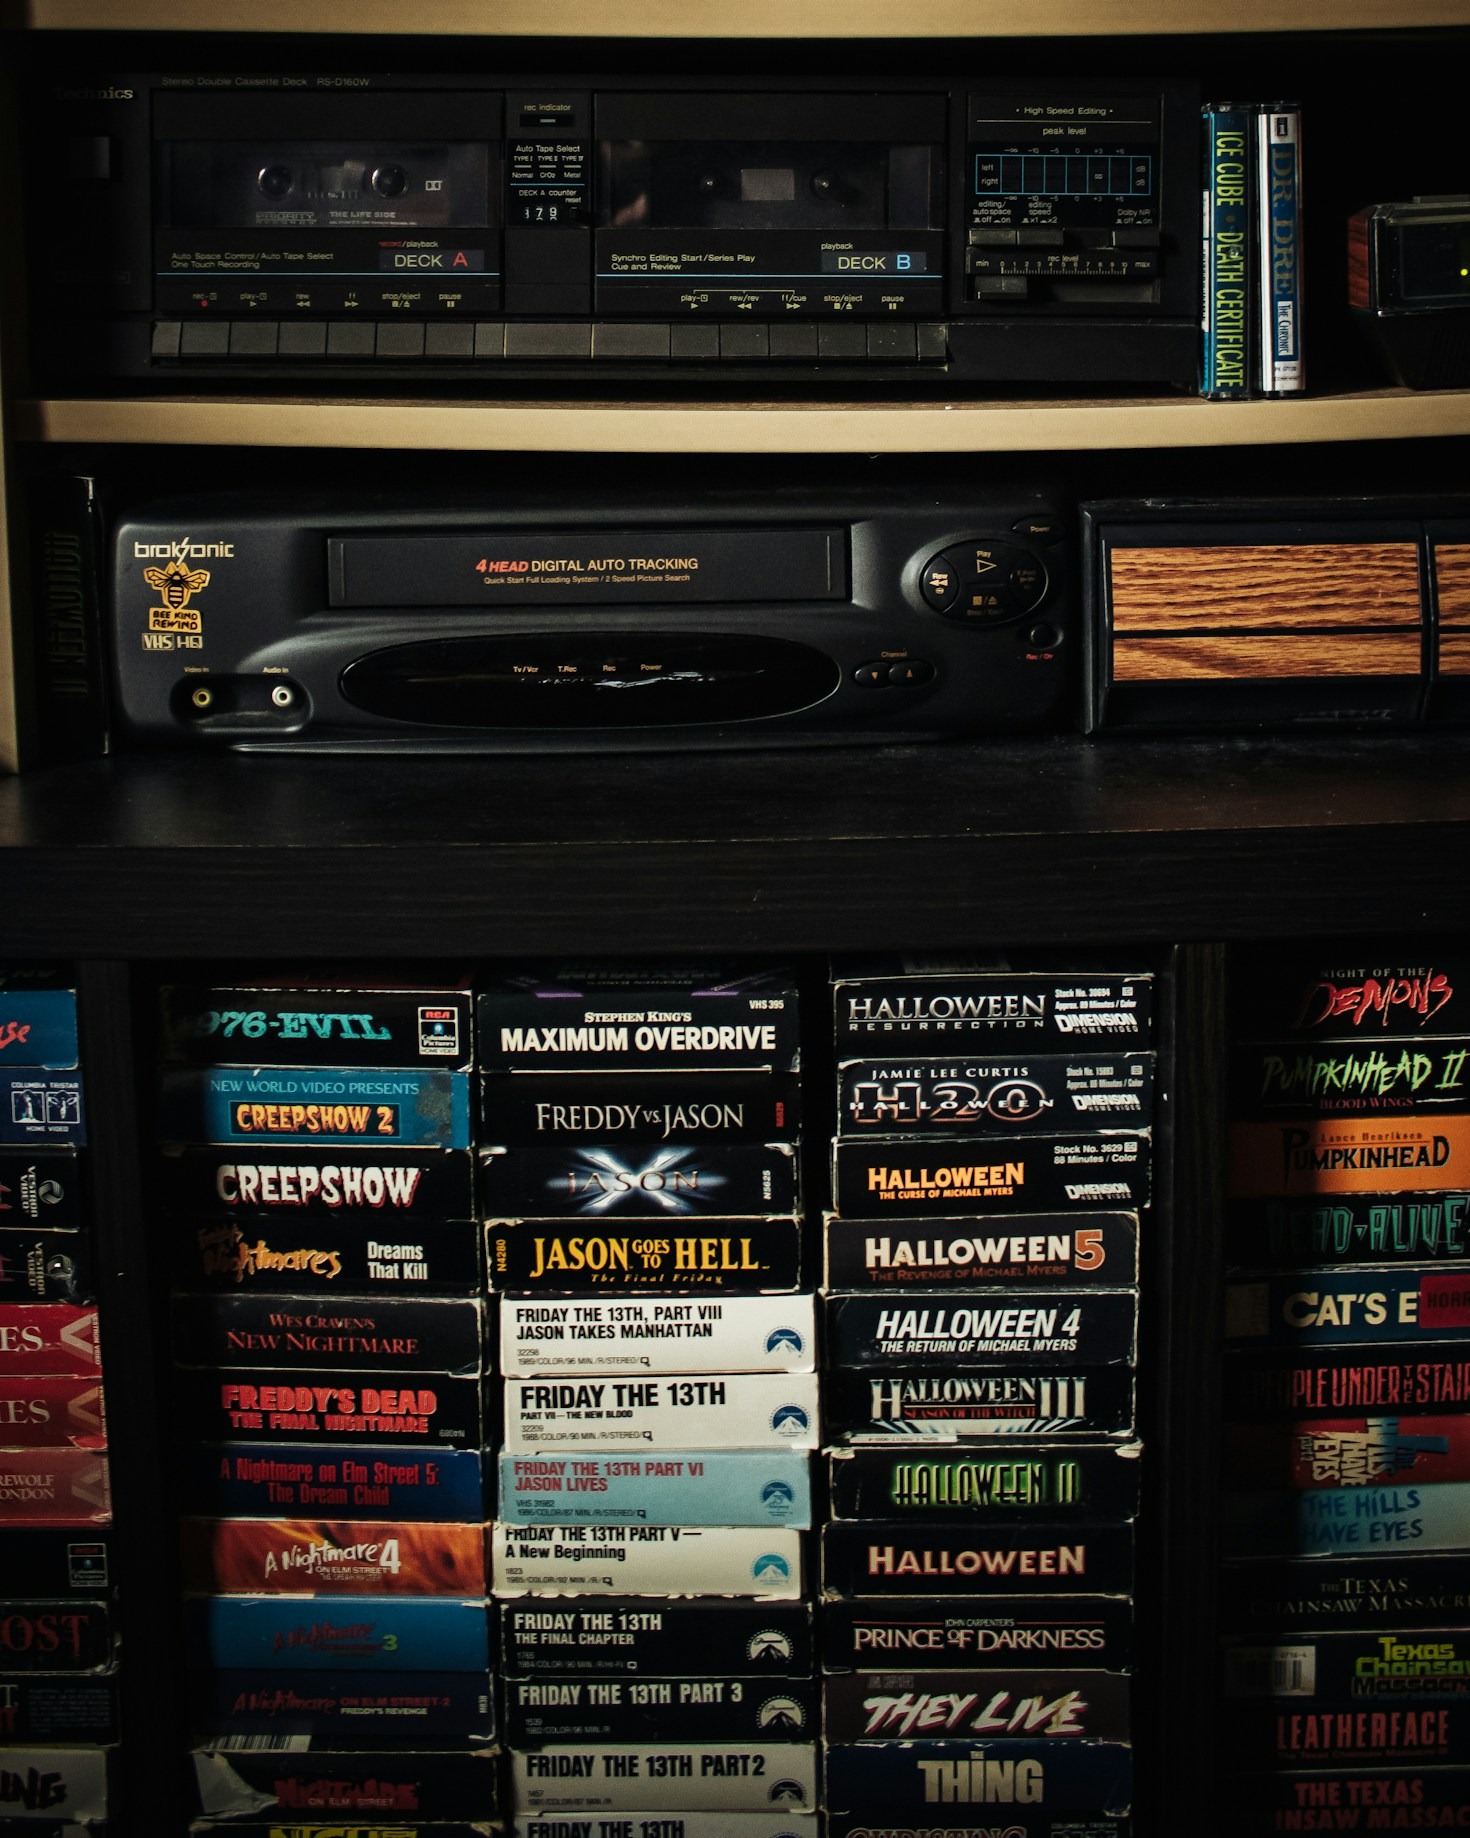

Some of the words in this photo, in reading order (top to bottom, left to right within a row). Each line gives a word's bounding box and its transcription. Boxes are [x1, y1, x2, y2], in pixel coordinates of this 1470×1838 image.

[162, 78, 194, 87] Stereo
[197, 78, 232, 87] Double
[234, 78, 279, 87] Cassette
[282, 78, 307, 87] Deck
[524, 104, 536, 112] rec
[538, 103, 572, 112] indicator
[1024, 106, 1043, 115] High
[1046, 106, 1074, 116] Speed
[1078, 106, 1106, 116] Editing
[1042, 127, 1064, 136] peak
[1068, 126, 1087, 136] level
[516, 145, 534, 153] Auto
[535, 145, 554, 154] Tape
[556, 145, 580, 153] Select
[1216, 130, 1244, 158] ICE
[1216, 162, 1244, 206] CUBE
[820, 242, 854, 251] playback
[1274, 216, 1296, 295] DRE
[170, 260, 186, 269] One
[188, 260, 212, 269] Touch
[214, 260, 260, 270] Recording
[394, 254, 442, 268] DECK
[452, 252, 469, 268] A
[610, 253, 648, 264] Synchro
[650, 253, 678, 264] Editing
[737, 253, 756, 264] Play
[610, 262, 628, 271] Cue
[630, 262, 648, 271] and
[650, 262, 682, 271] Review
[838, 256, 886, 271] DECK
[896, 254, 911, 270] B
[1216, 232, 1244, 282] DEATH
[1277, 304, 1292, 319] THE
[1215, 288, 1244, 388] CERTIFICATE
[1277, 320, 1292, 354] CHRONIC
[475, 559, 488, 574] 4
[488, 560, 529, 573] HEAD
[531, 560, 585, 572] DIGITAL
[587, 559, 626, 572] AUTO
[628, 558, 699, 571] TRACKING
[484, 576, 504, 584] Quick
[506, 576, 524, 584] Start
[525, 576, 538, 584] Full
[540, 576, 570, 585] Loading
[571, 575, 599, 584] System
[612, 575, 635, 584] Speed
[636, 574, 662, 583] Picture
[665, 574, 690, 582] Search
[153, 610, 171, 619] BEE
[174, 611, 198, 620] KIND
[152, 620, 198, 630] REWIND
[1320, 968, 1366, 980] NIGHT
[1372, 968, 1392, 978] OF
[1396, 967, 1426, 977] THE
[425, 1010, 451, 1019] RCA
[848, 994, 1046, 1021] HALLOWEEN
[584, 1012, 644, 1024] STEPHEN
[647, 1011, 692, 1023] KING'S
[849, 1019, 1045, 1032] RESURRECTION
[500, 1026, 629, 1052] MAXIMUM
[634, 1025, 777, 1052] OVERDRIVE
[872, 1067, 922, 1080] JAMIE
[930, 1067, 958, 1079] LEE
[966, 1066, 1030, 1078] CURTIS
[210, 1080, 244, 1093] NEW
[246, 1080, 298, 1094] WORLD
[301, 1080, 345, 1094] VIDEO
[348, 1082, 420, 1096] PRESENTS
[1320, 1098, 1366, 1110] BLOOD
[1369, 1096, 1416, 1109] WINGS
[236, 1104, 370, 1133] CREEPSHOW
[376, 1104, 395, 1136] 2
[868, 1162, 1026, 1191] HALLOWEEN
[216, 1164, 422, 1209] CREEPSHOW
[879, 1190, 897, 1200] THE
[898, 1190, 926, 1200] CURSE
[928, 1189, 942, 1199] OF
[942, 1188, 982, 1198] MICHAEL
[984, 1186, 1014, 1198] MYERS
[367, 1240, 424, 1262] Dreams
[496, 1238, 508, 1272] N4280
[865, 1236, 1070, 1269] HALLOWEEN
[1074, 1228, 1106, 1272] 5
[368, 1262, 400, 1280] That
[402, 1262, 429, 1281] Kill
[516, 1308, 569, 1324] FRIDAY
[574, 1306, 602, 1322] THE
[607, 1306, 649, 1324] 13TH,
[654, 1306, 696, 1321] PART
[698, 1305, 722, 1320] VIII
[1283, 1291, 1388, 1328] CAT'S
[876, 1309, 1060, 1340] HALLOWEEN
[1060, 1308, 1082, 1338] 4
[226, 1330, 281, 1350] NEW
[285, 1332, 420, 1356] NIGHTMARE
[880, 1340, 904, 1353] THE
[906, 1340, 957, 1353] RETURN
[958, 1340, 976, 1352] OF
[977, 1339, 1030, 1352] MICHAEL
[1032, 1338, 1078, 1352] MYERS
[221, 1384, 356, 1414] FREDDY'S
[361, 1388, 438, 1416] DEAD
[520, 1384, 606, 1410] FRIDAY
[612, 1383, 659, 1408] THE
[666, 1382, 726, 1406] 13TH
[229, 1412, 263, 1429] THE
[268, 1413, 320, 1431] FINAL
[324, 1414, 430, 1434] NIGHTMARE
[514, 1462, 568, 1477] FRIDAY
[570, 1462, 600, 1477] THE
[604, 1462, 640, 1477] 13TH
[645, 1462, 685, 1477] PART
[688, 1462, 704, 1477] VI
[268, 1482, 294, 1504] The
[300, 1483, 348, 1506] Dream
[354, 1484, 390, 1506] Child
[514, 1478, 562, 1492] JASON
[566, 1478, 608, 1492] LIVES
[1301, 1494, 1348, 1518] THE
[1356, 1489, 1421, 1518] HILLS
[1304, 1522, 1359, 1544] HAVE
[1369, 1518, 1424, 1542] EYES
[505, 1544, 515, 1558] A
[520, 1544, 550, 1558] New
[554, 1544, 626, 1562] Beginning
[868, 1544, 1086, 1576] HALLOWEEN
[514, 1632, 538, 1646] THE
[540, 1632, 576, 1646] FINAL
[578, 1632, 635, 1646] CHAPTER
[1378, 1636, 1456, 1662] Texas
[518, 1684, 582, 1706] FRIDAY
[587, 1684, 622, 1706] THE
[628, 1684, 672, 1706] 13TH
[680, 1682, 724, 1704] PART
[730, 1682, 744, 1704] 3
[863, 1692, 978, 1737] THEY
[970, 1690, 1090, 1737] LIVE
[1276, 1709, 1450, 1751] LEATHERFACE
[918, 1759, 1044, 1804] THING
[1294, 1780, 1342, 1807] THE
[1347, 1778, 1424, 1806] TEXAS
